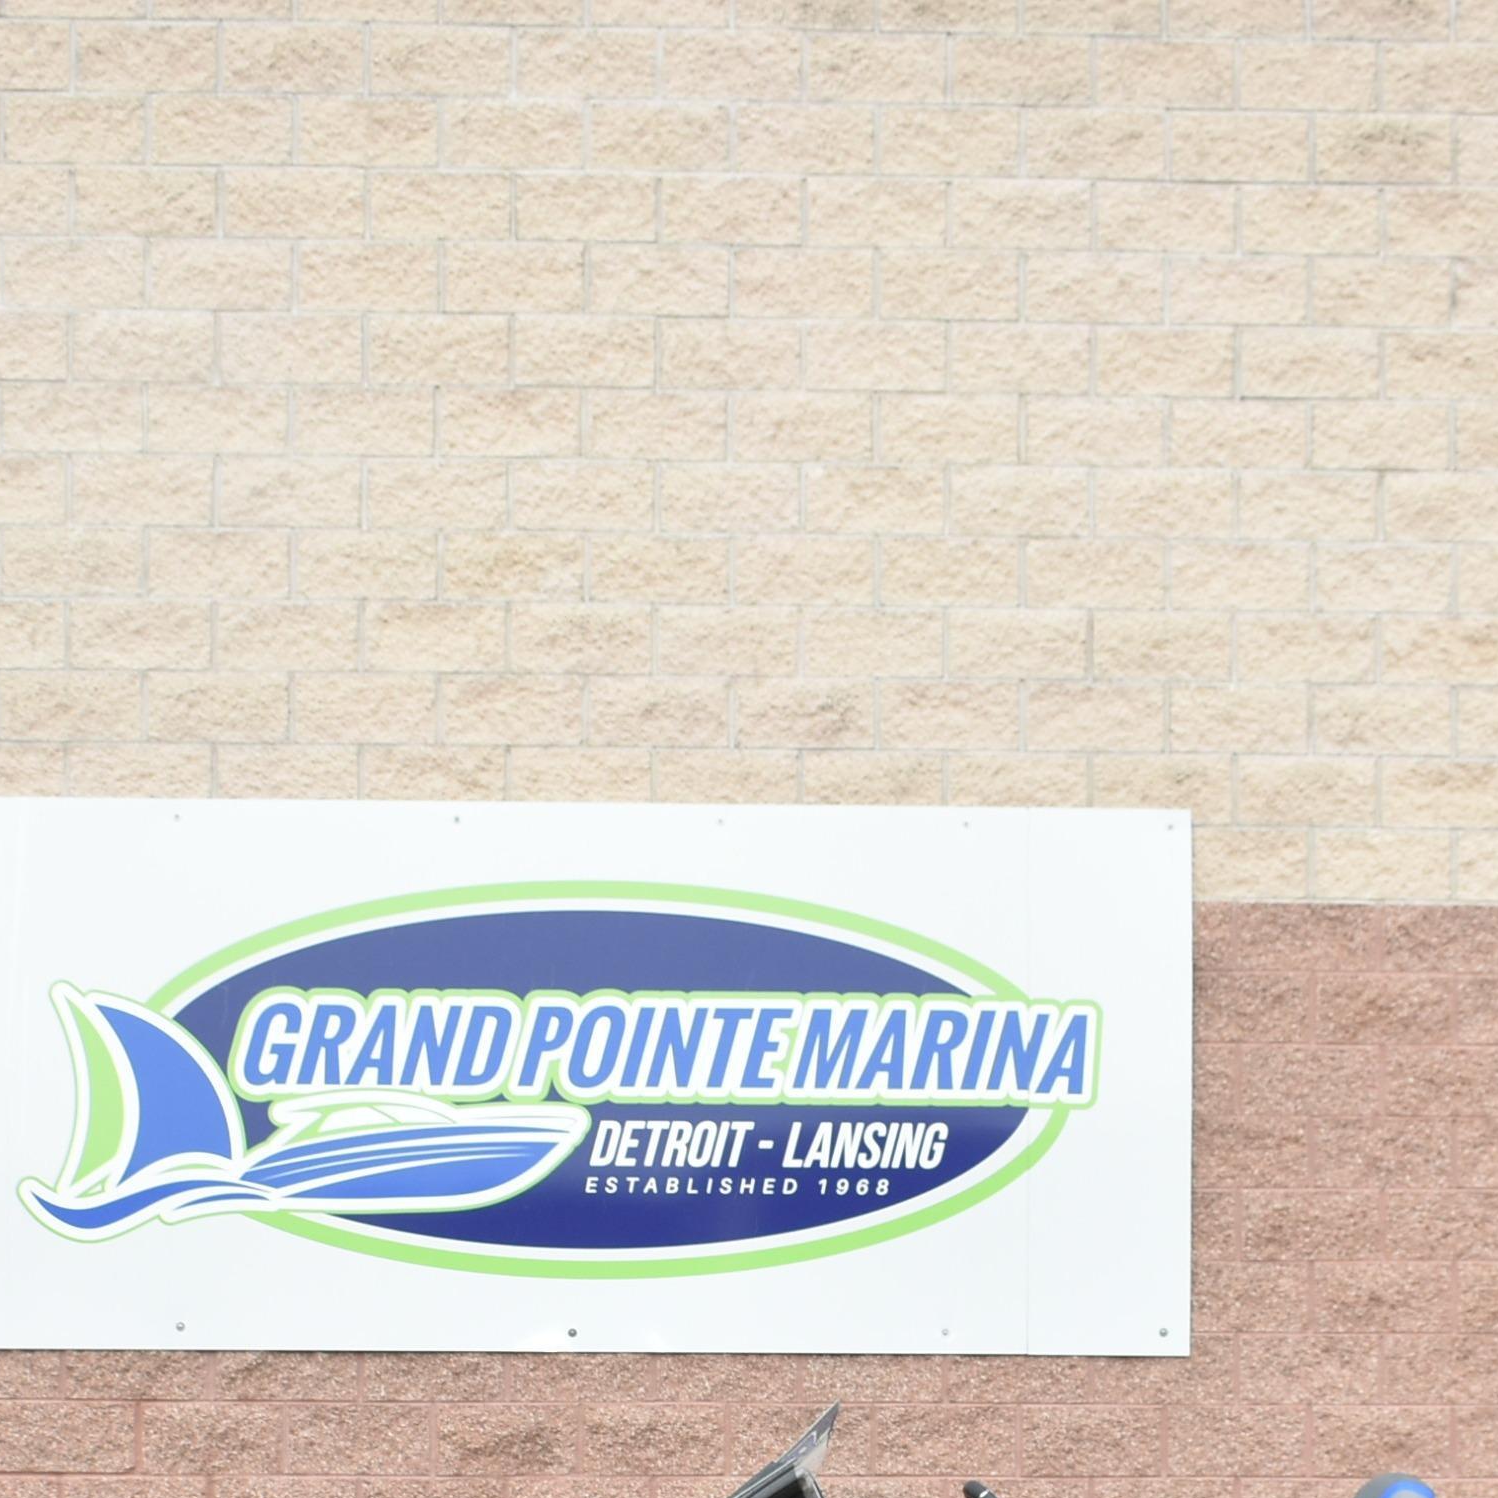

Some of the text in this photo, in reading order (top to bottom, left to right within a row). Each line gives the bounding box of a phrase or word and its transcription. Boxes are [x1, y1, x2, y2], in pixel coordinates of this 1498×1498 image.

[243, 1002, 1089, 1096] GRAND POINTE MARINA
[589, 1119, 755, 1168] DETROIT
[781, 1121, 949, 1170] LANSING
[584, 1176, 891, 1196] ESTABLISHED 1968
